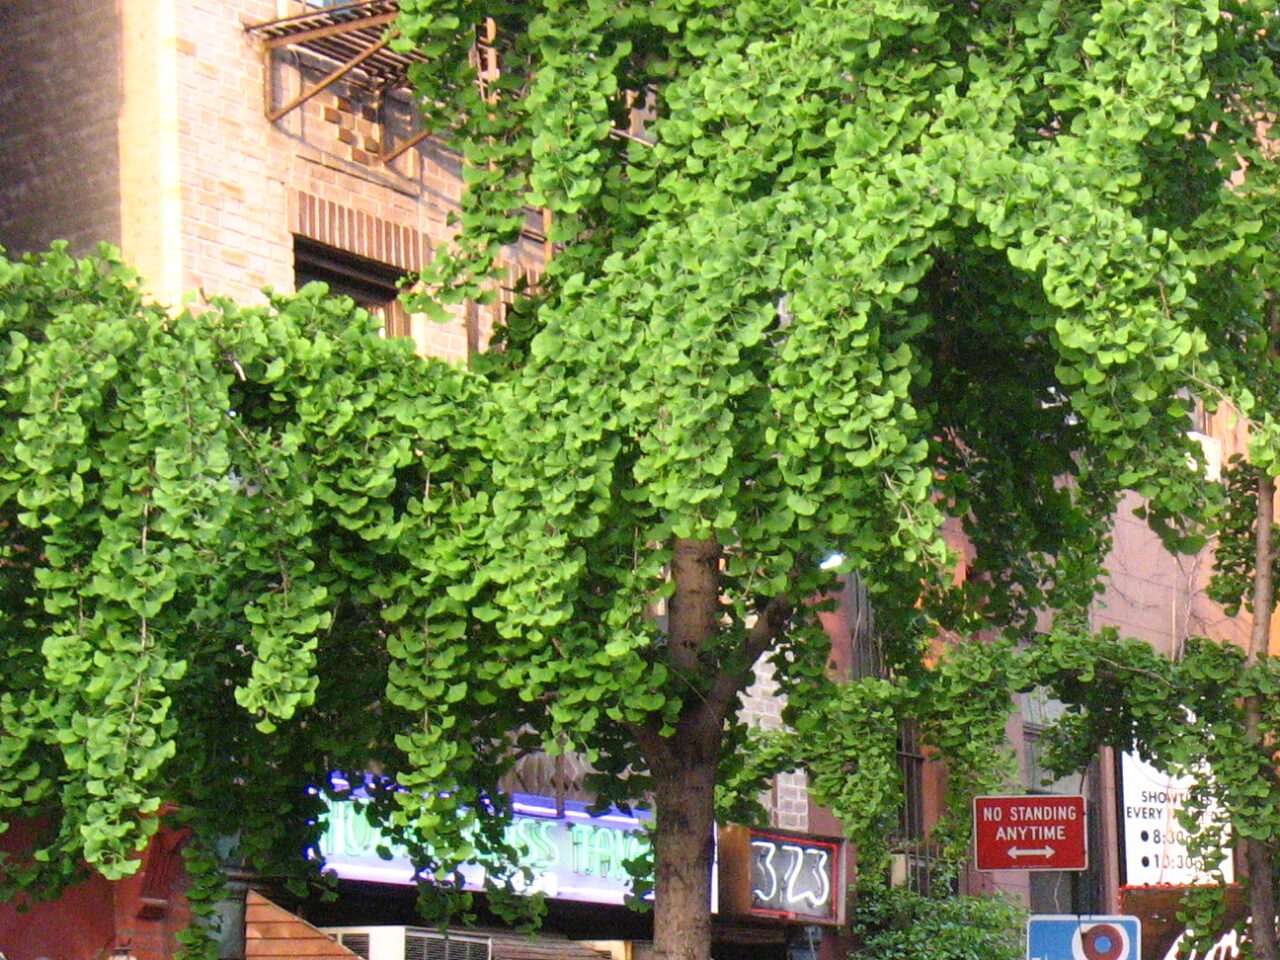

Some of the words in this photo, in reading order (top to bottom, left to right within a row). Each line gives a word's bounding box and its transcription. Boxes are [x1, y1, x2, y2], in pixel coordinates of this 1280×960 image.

[983, 806, 1003, 822] NO
[1009, 805, 1077, 821] STANDING
[1126, 806, 1164, 820] EVERY
[995, 825, 1067, 841] ANYTIME
